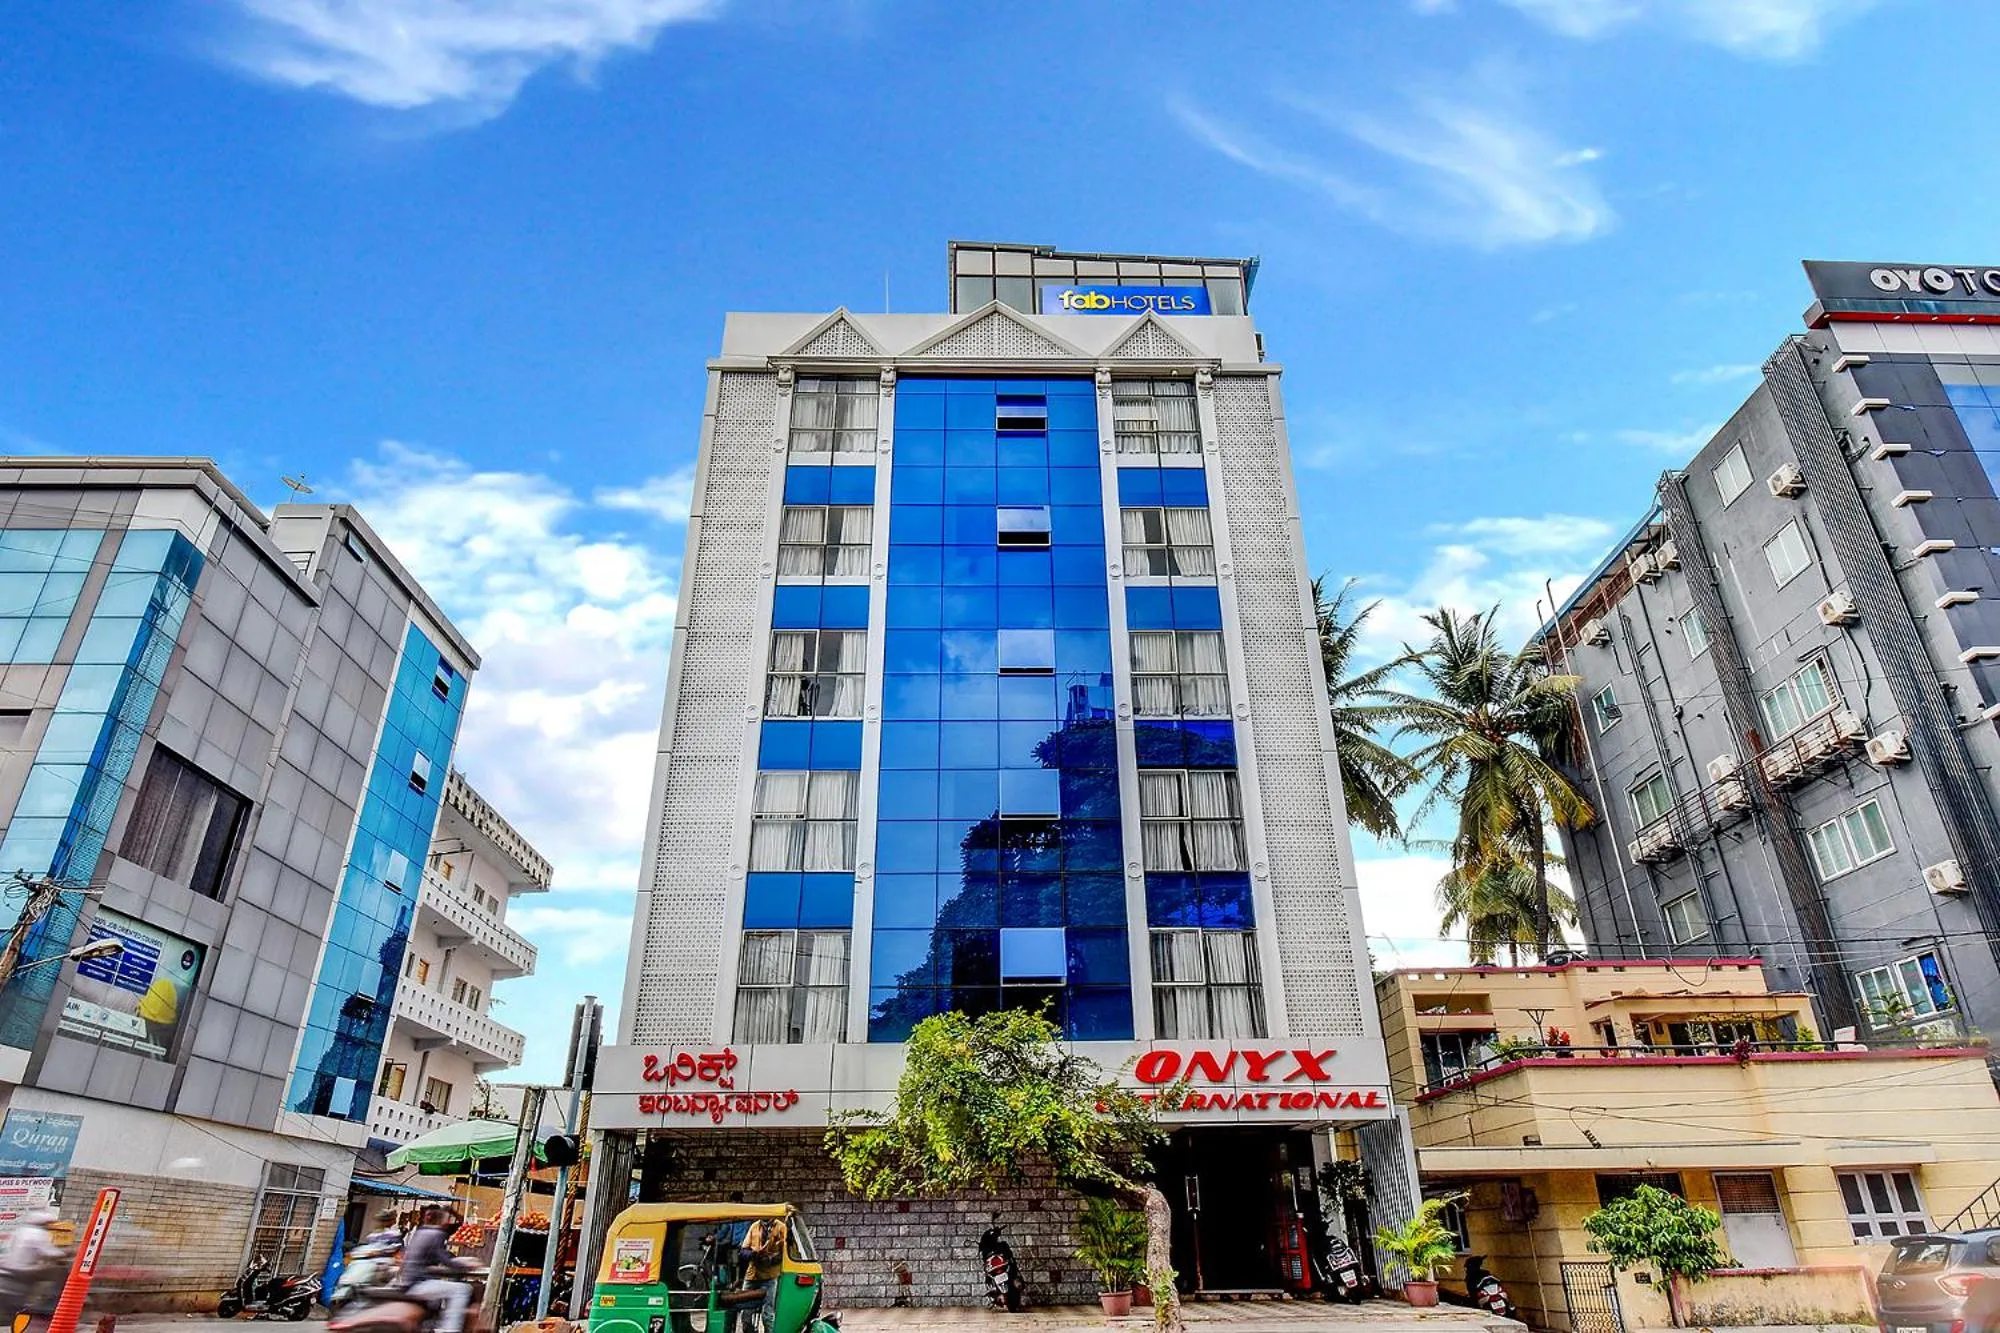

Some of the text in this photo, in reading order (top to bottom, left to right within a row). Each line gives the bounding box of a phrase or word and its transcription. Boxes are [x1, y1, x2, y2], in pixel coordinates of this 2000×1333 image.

[1870, 267, 1954, 293] OYO
[1135, 1050, 1336, 1083] ONYX
[11, 1128, 69, 1149] Quran
